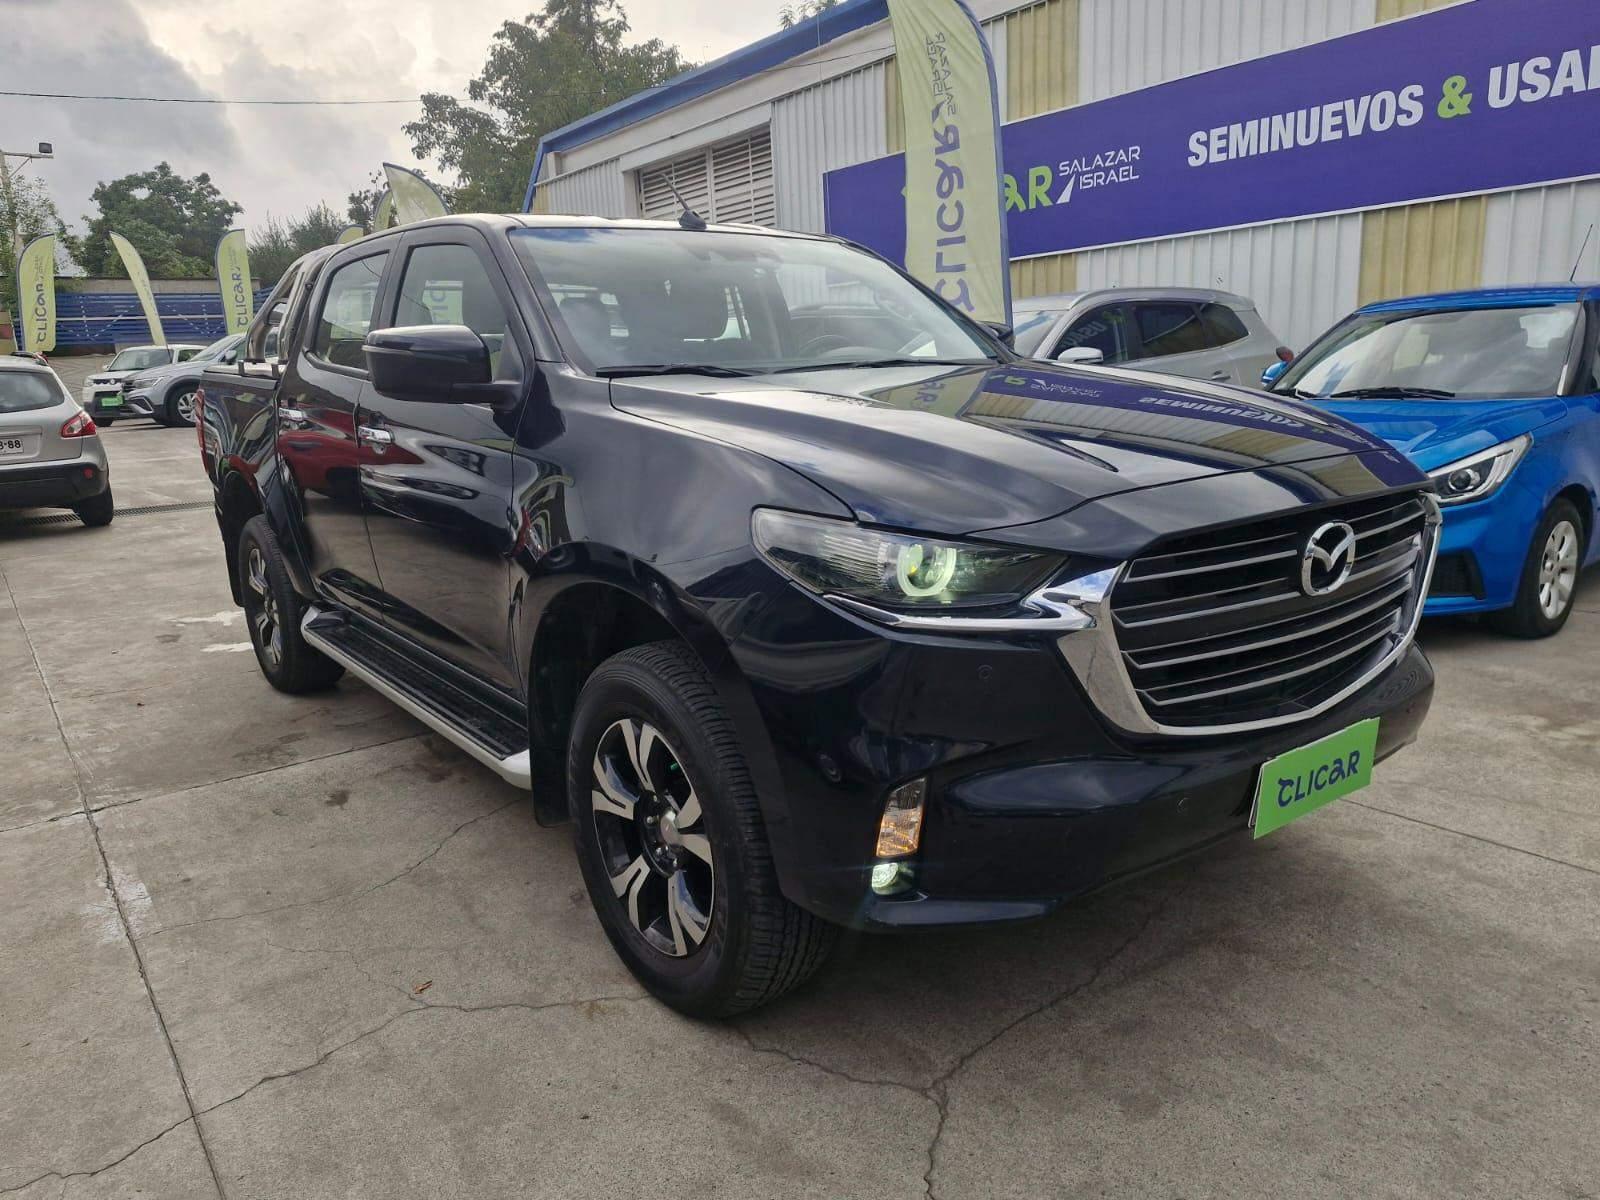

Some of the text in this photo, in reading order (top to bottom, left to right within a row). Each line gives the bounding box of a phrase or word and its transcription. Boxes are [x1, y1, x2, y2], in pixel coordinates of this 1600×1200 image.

[1187, 84, 1424, 168] SEMINUEVOS
[1436, 75, 1473, 119] &
[1059, 145, 1141, 176] SALAZAR
[1079, 164, 1140, 190] ISRAEL
